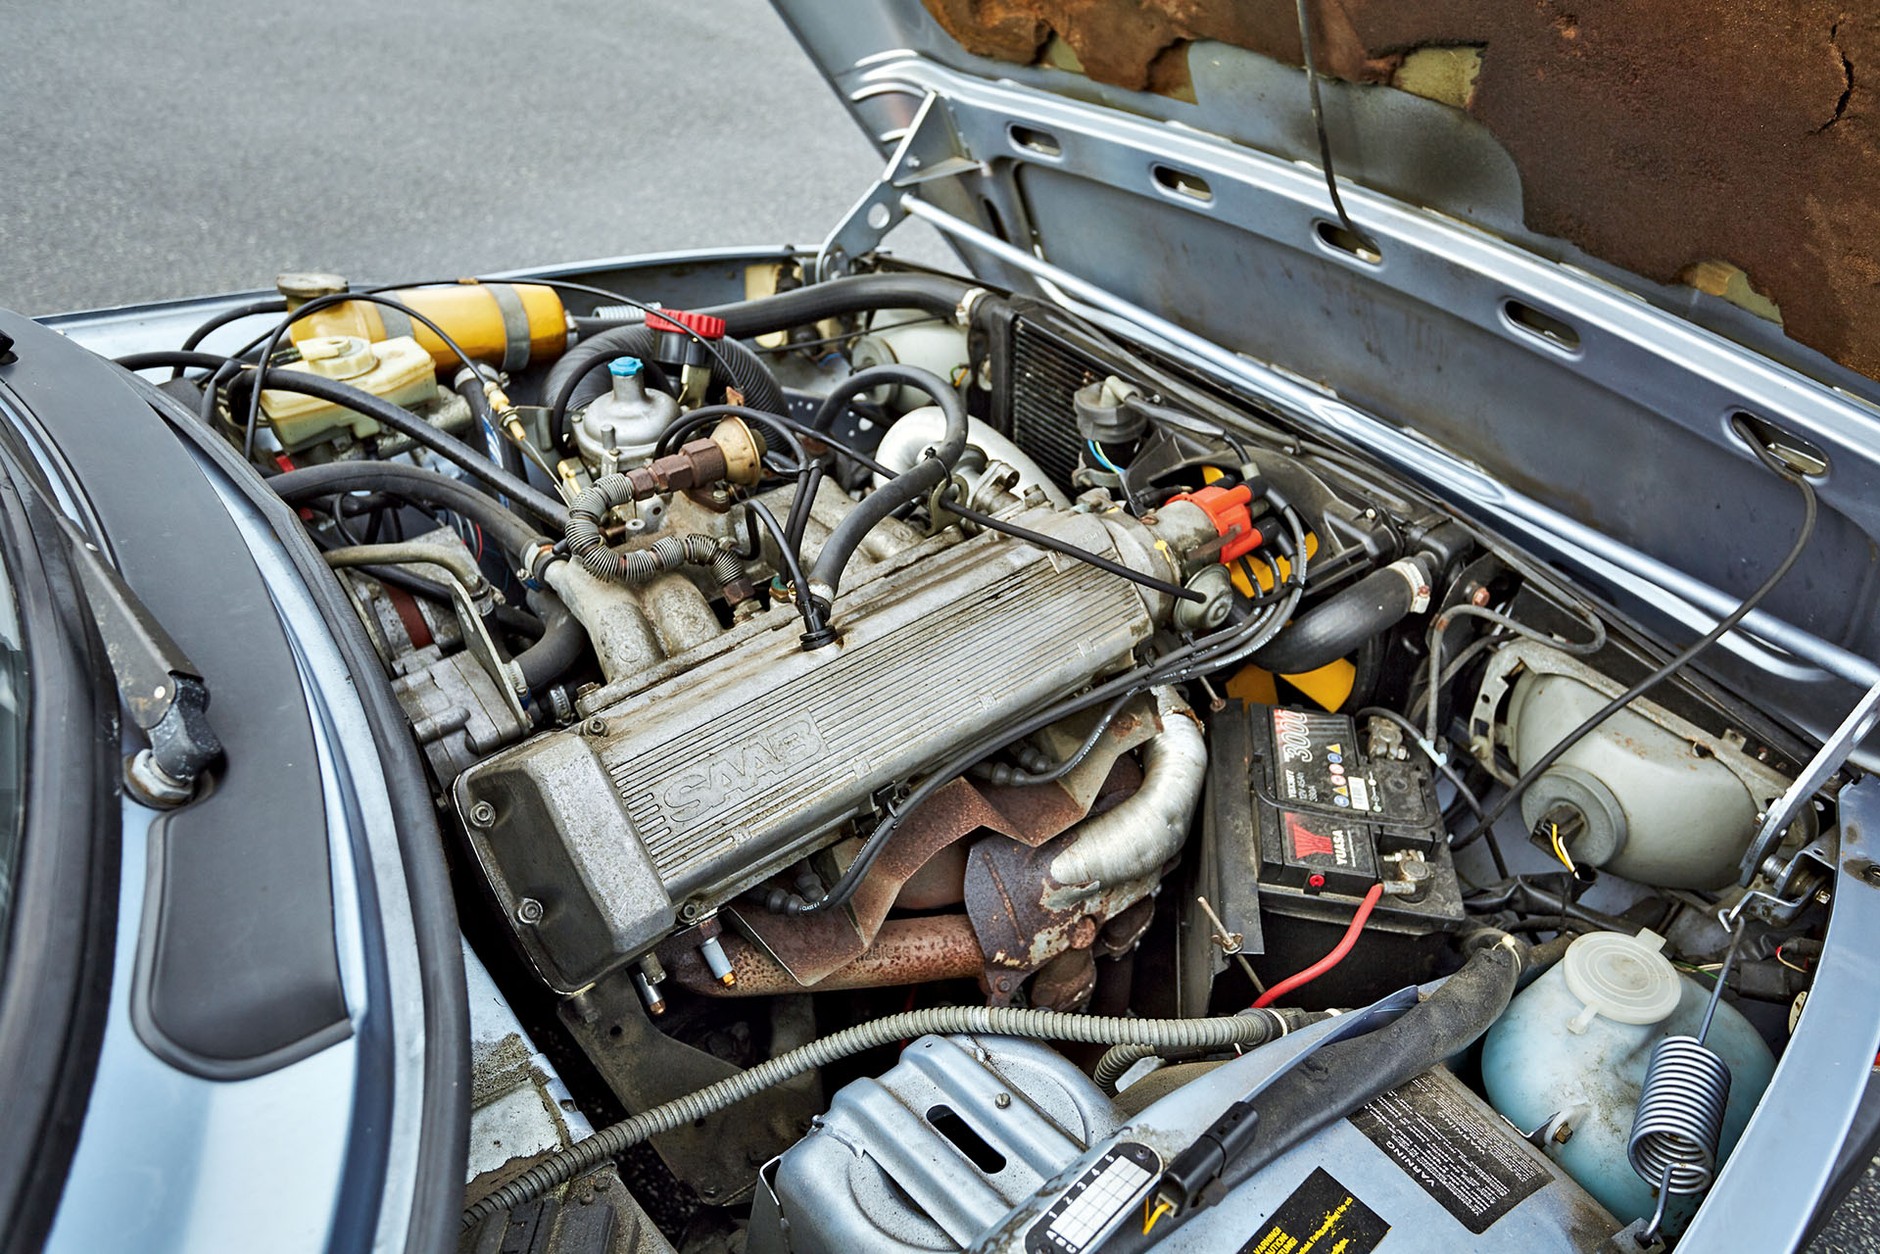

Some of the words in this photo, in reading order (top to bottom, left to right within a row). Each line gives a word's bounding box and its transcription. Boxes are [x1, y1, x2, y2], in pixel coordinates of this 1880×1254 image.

[1281, 709, 1313, 762] 3000
[663, 719, 822, 823] SAAB
[1332, 829, 1348, 865] YUASA
[1437, 1111, 1486, 1155] WARNING
[1048, 1210, 1058, 1219] 1
[1063, 1196, 1074, 1205] 2
[1077, 1181, 1087, 1191] 3
[1091, 1168, 1101, 1178] 4
[1105, 1153, 1115, 1163] 5
[1385, 1140, 1436, 1188] VARNING
[1046, 1229, 1058, 1241] A
[1055, 1237, 1066, 1247] B
[1066, 1244, 1077, 1254] C
